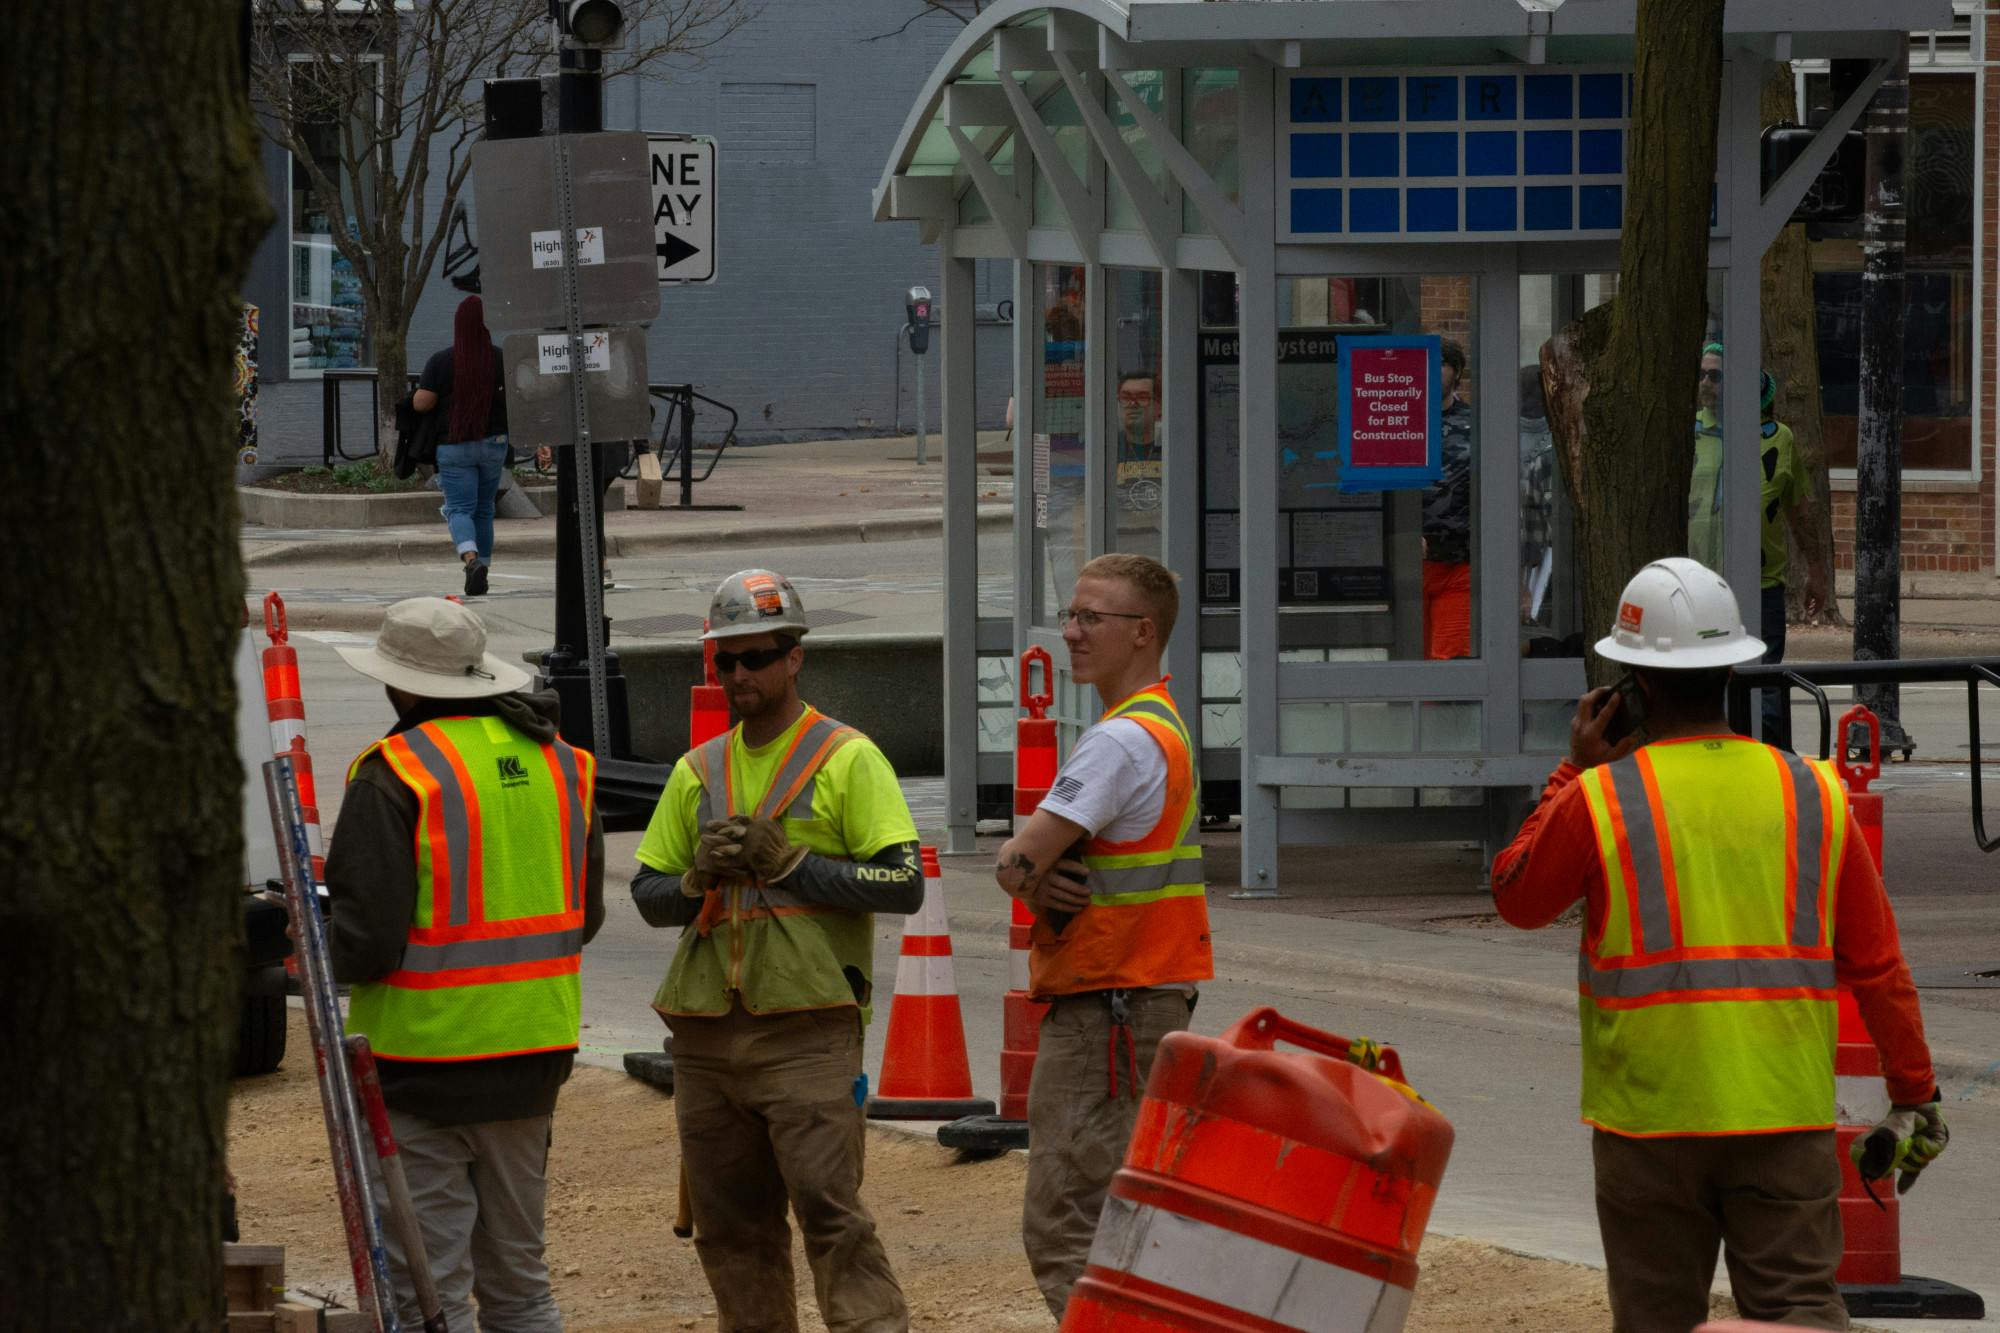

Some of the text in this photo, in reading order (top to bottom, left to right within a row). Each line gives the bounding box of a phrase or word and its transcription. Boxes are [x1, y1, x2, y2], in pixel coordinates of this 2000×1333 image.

[1421, 82, 1441, 113] F
[1479, 80, 1503, 114] R
[651, 153, 701, 186] NE
[654, 193, 702, 226] AY
[1203, 338, 1336, 360] Met ystem
[1364, 373, 1414, 385] Bus Stop
[1355, 387, 1422, 399] Temporarily
[1369, 401, 1409, 412] Closed
[1368, 415, 1410, 426] for BRT
[1353, 430, 1425, 441] Construction
